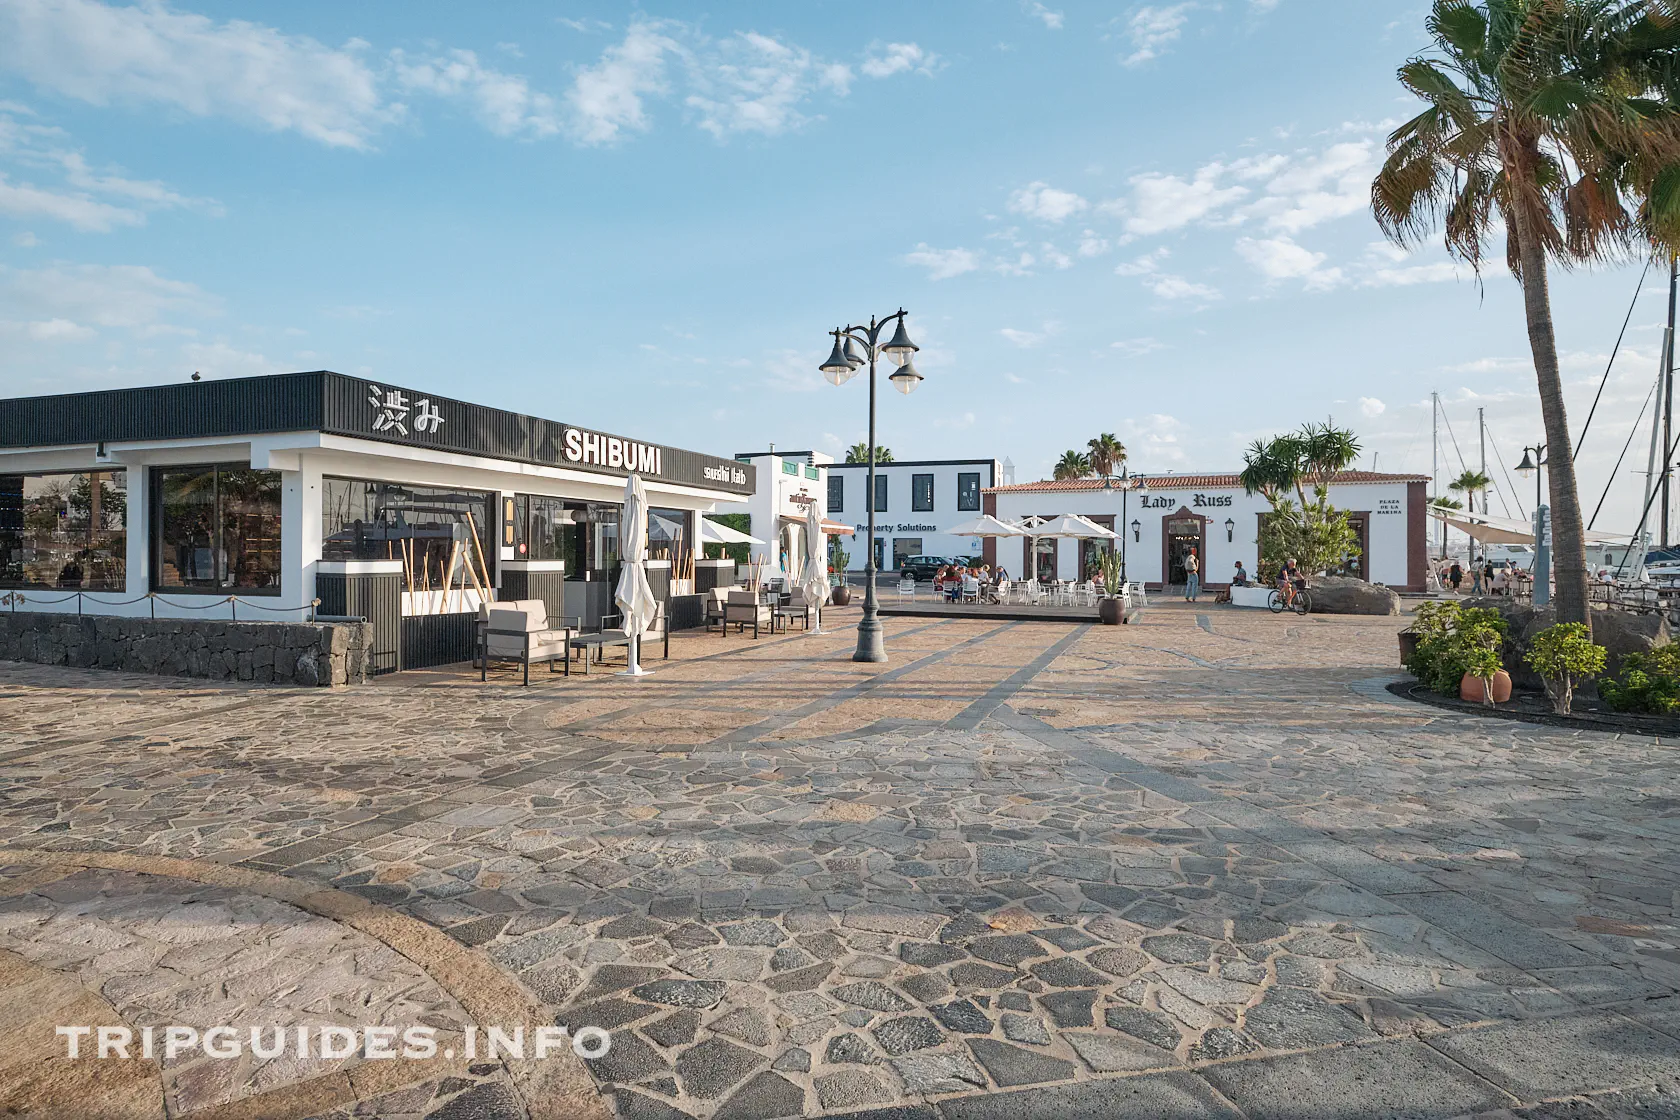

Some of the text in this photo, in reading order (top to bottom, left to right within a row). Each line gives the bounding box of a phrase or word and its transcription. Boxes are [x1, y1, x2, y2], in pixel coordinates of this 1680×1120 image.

[368, 384, 445, 436] 渋み
[563, 428, 662, 475] SHIBUMI
[703, 465, 746, 484] sushi lab
[1140, 493, 1232, 511] Lady Russ
[856, 523, 937, 533] Proerty Solutions
